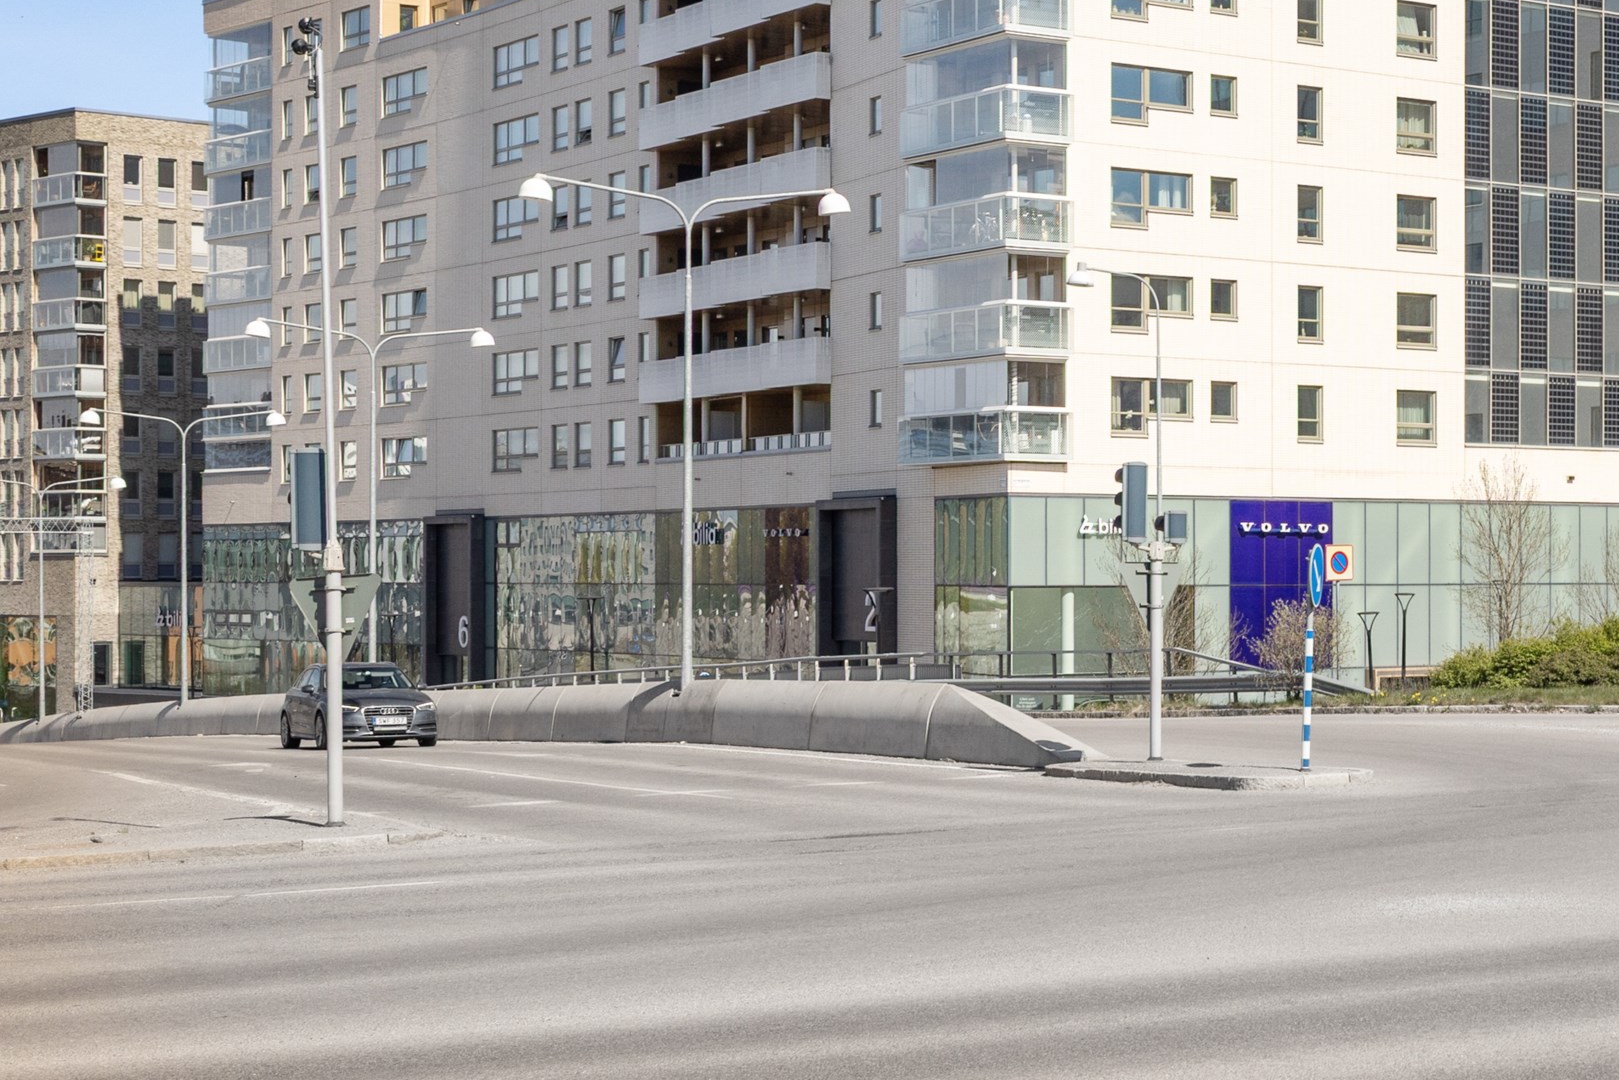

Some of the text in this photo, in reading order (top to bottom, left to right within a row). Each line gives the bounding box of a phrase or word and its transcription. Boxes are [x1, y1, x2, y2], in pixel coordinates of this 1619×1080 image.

[763, 528, 801, 537] VOLVO
[1240, 522, 1330, 534] VOLVO
[165, 608, 182, 627] bili
[865, 590, 876, 632] 2
[458, 615, 469, 648] 6
